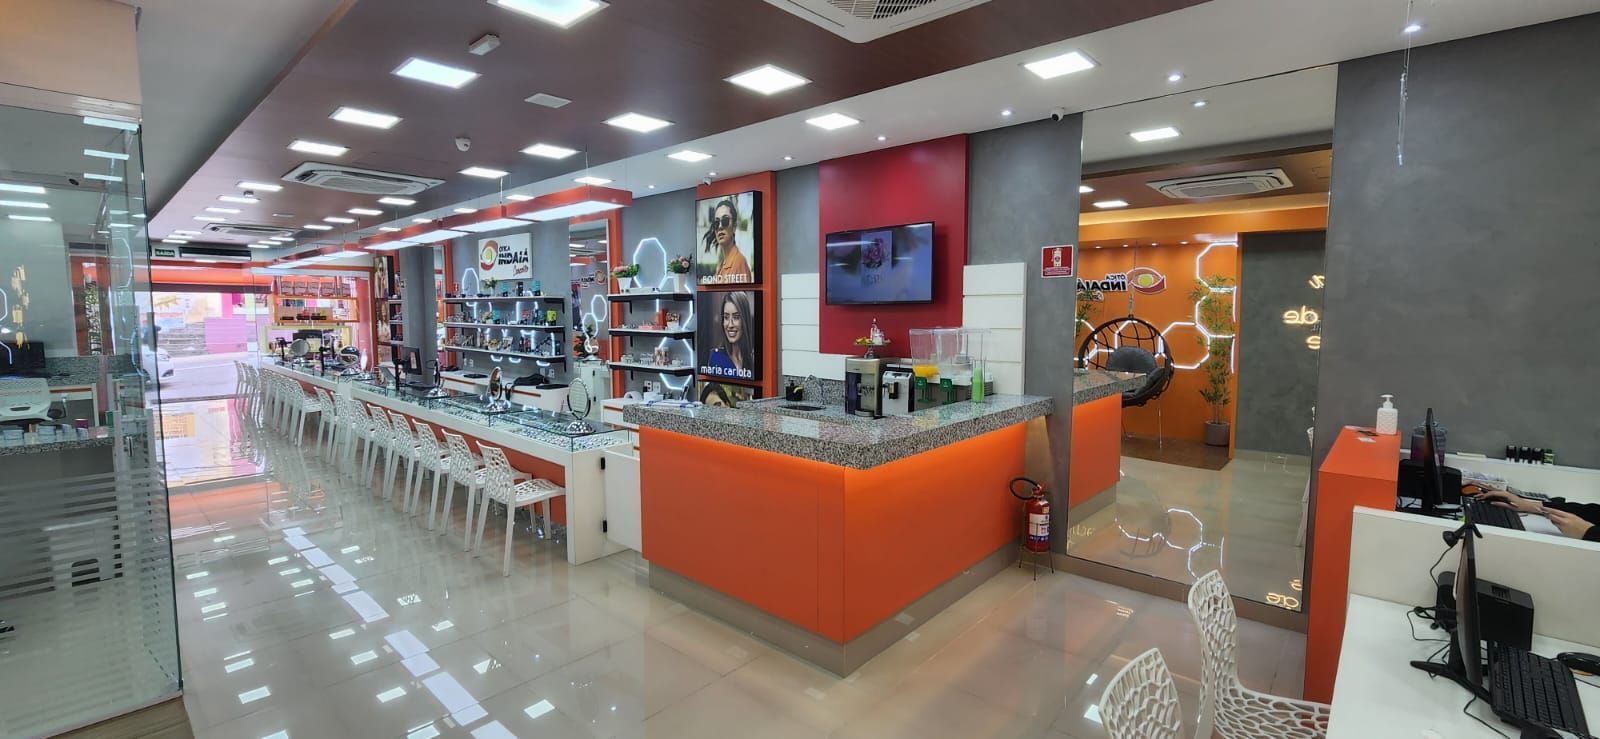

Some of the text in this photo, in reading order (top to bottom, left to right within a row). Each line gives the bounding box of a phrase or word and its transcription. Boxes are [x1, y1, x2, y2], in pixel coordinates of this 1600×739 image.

[498, 248, 529, 265] INDAIÁ
[703, 273, 747, 284] BOND STREET
[701, 364, 752, 378] maria carlota
